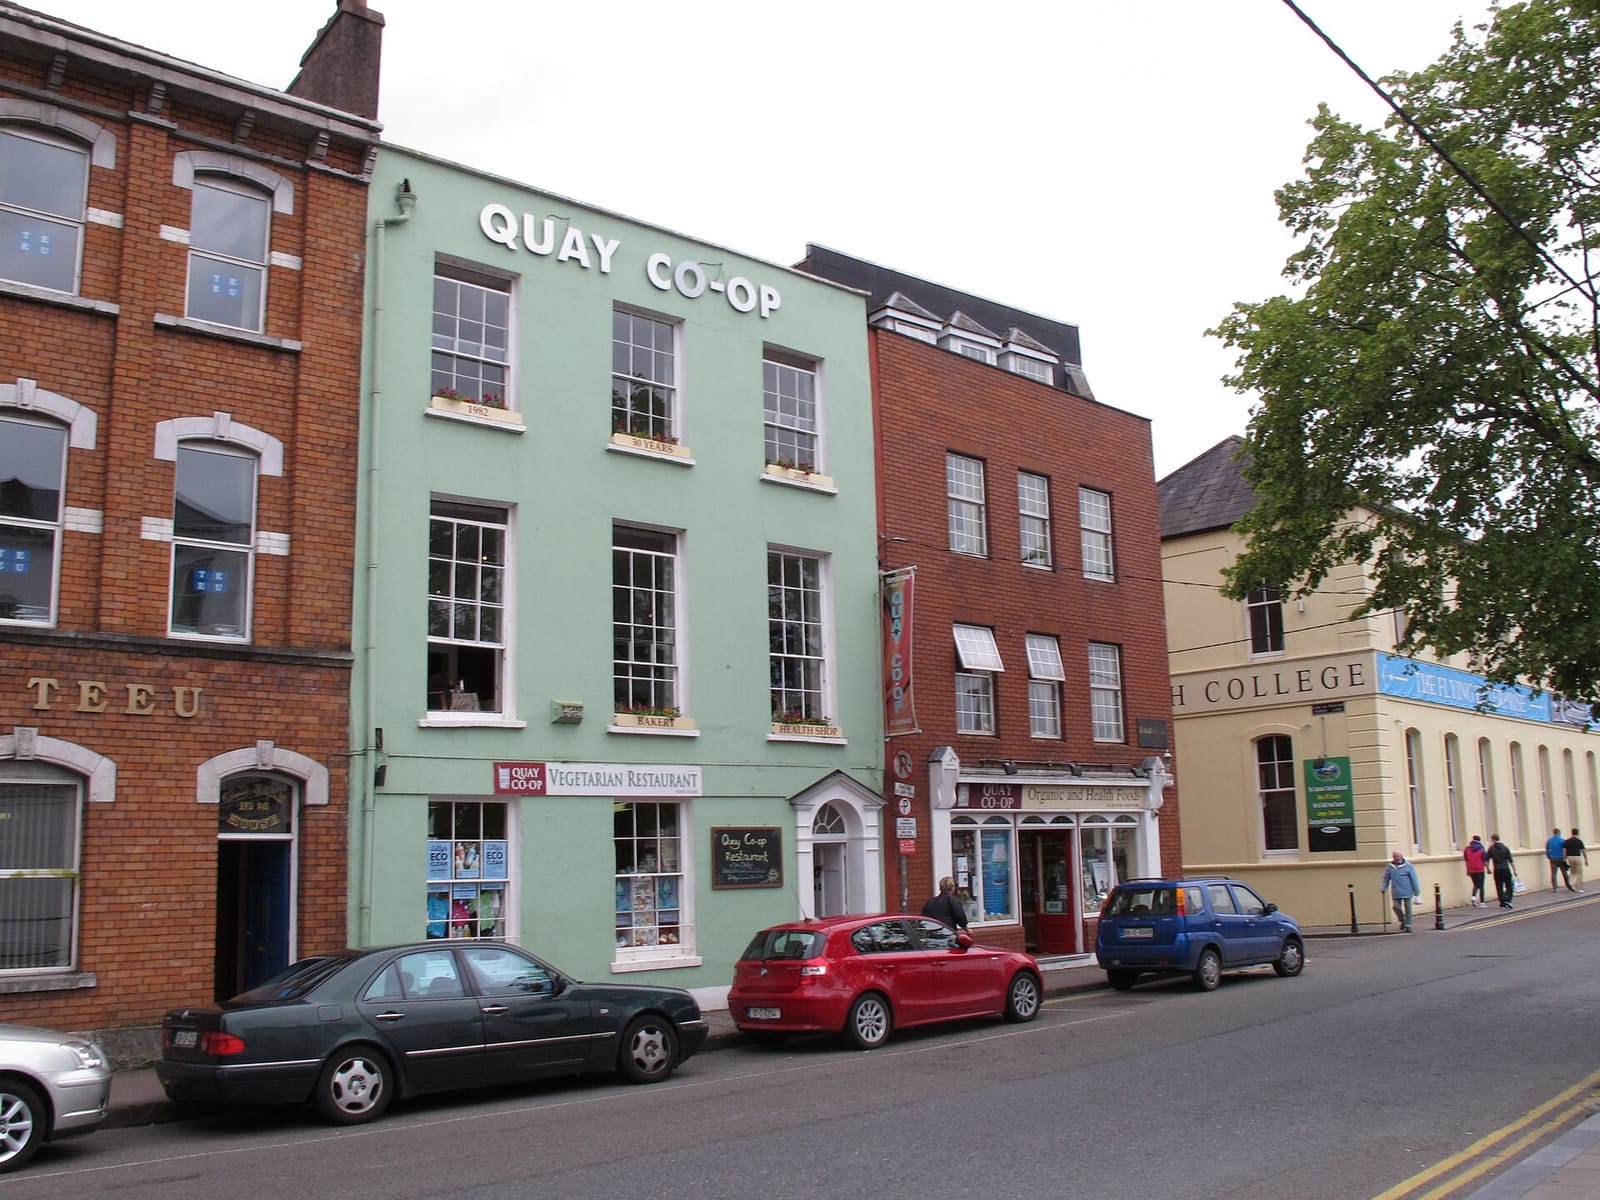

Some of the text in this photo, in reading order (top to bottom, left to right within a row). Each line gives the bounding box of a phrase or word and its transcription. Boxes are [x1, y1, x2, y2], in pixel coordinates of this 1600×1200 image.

[479, 203, 782, 318] QUAY CO-OP
[467, 405, 489, 417] 1982
[631, 437, 674, 454] 30 YEARS
[890, 591, 904, 645] QUAY
[1205, 663, 1366, 703] COLLEGE
[1415, 671, 1437, 697] THE
[1438, 675, 1473, 704] FLYING
[27, 677, 203, 718] TEEU
[637, 716, 675, 727] BAKERY
[779, 725, 838, 736] HEALTH SHOP
[511, 767, 540, 779] QUAY
[511, 779, 543, 791] CO-OP
[982, 784, 1014, 797] QUAY
[1028, 786, 1141, 804] Organic and Health Foods
[981, 796, 1015, 809] CO-OP
[430, 853, 449, 861] ECO
[486, 851, 504, 860] ECO
[724, 850, 769, 863] Restaurant
